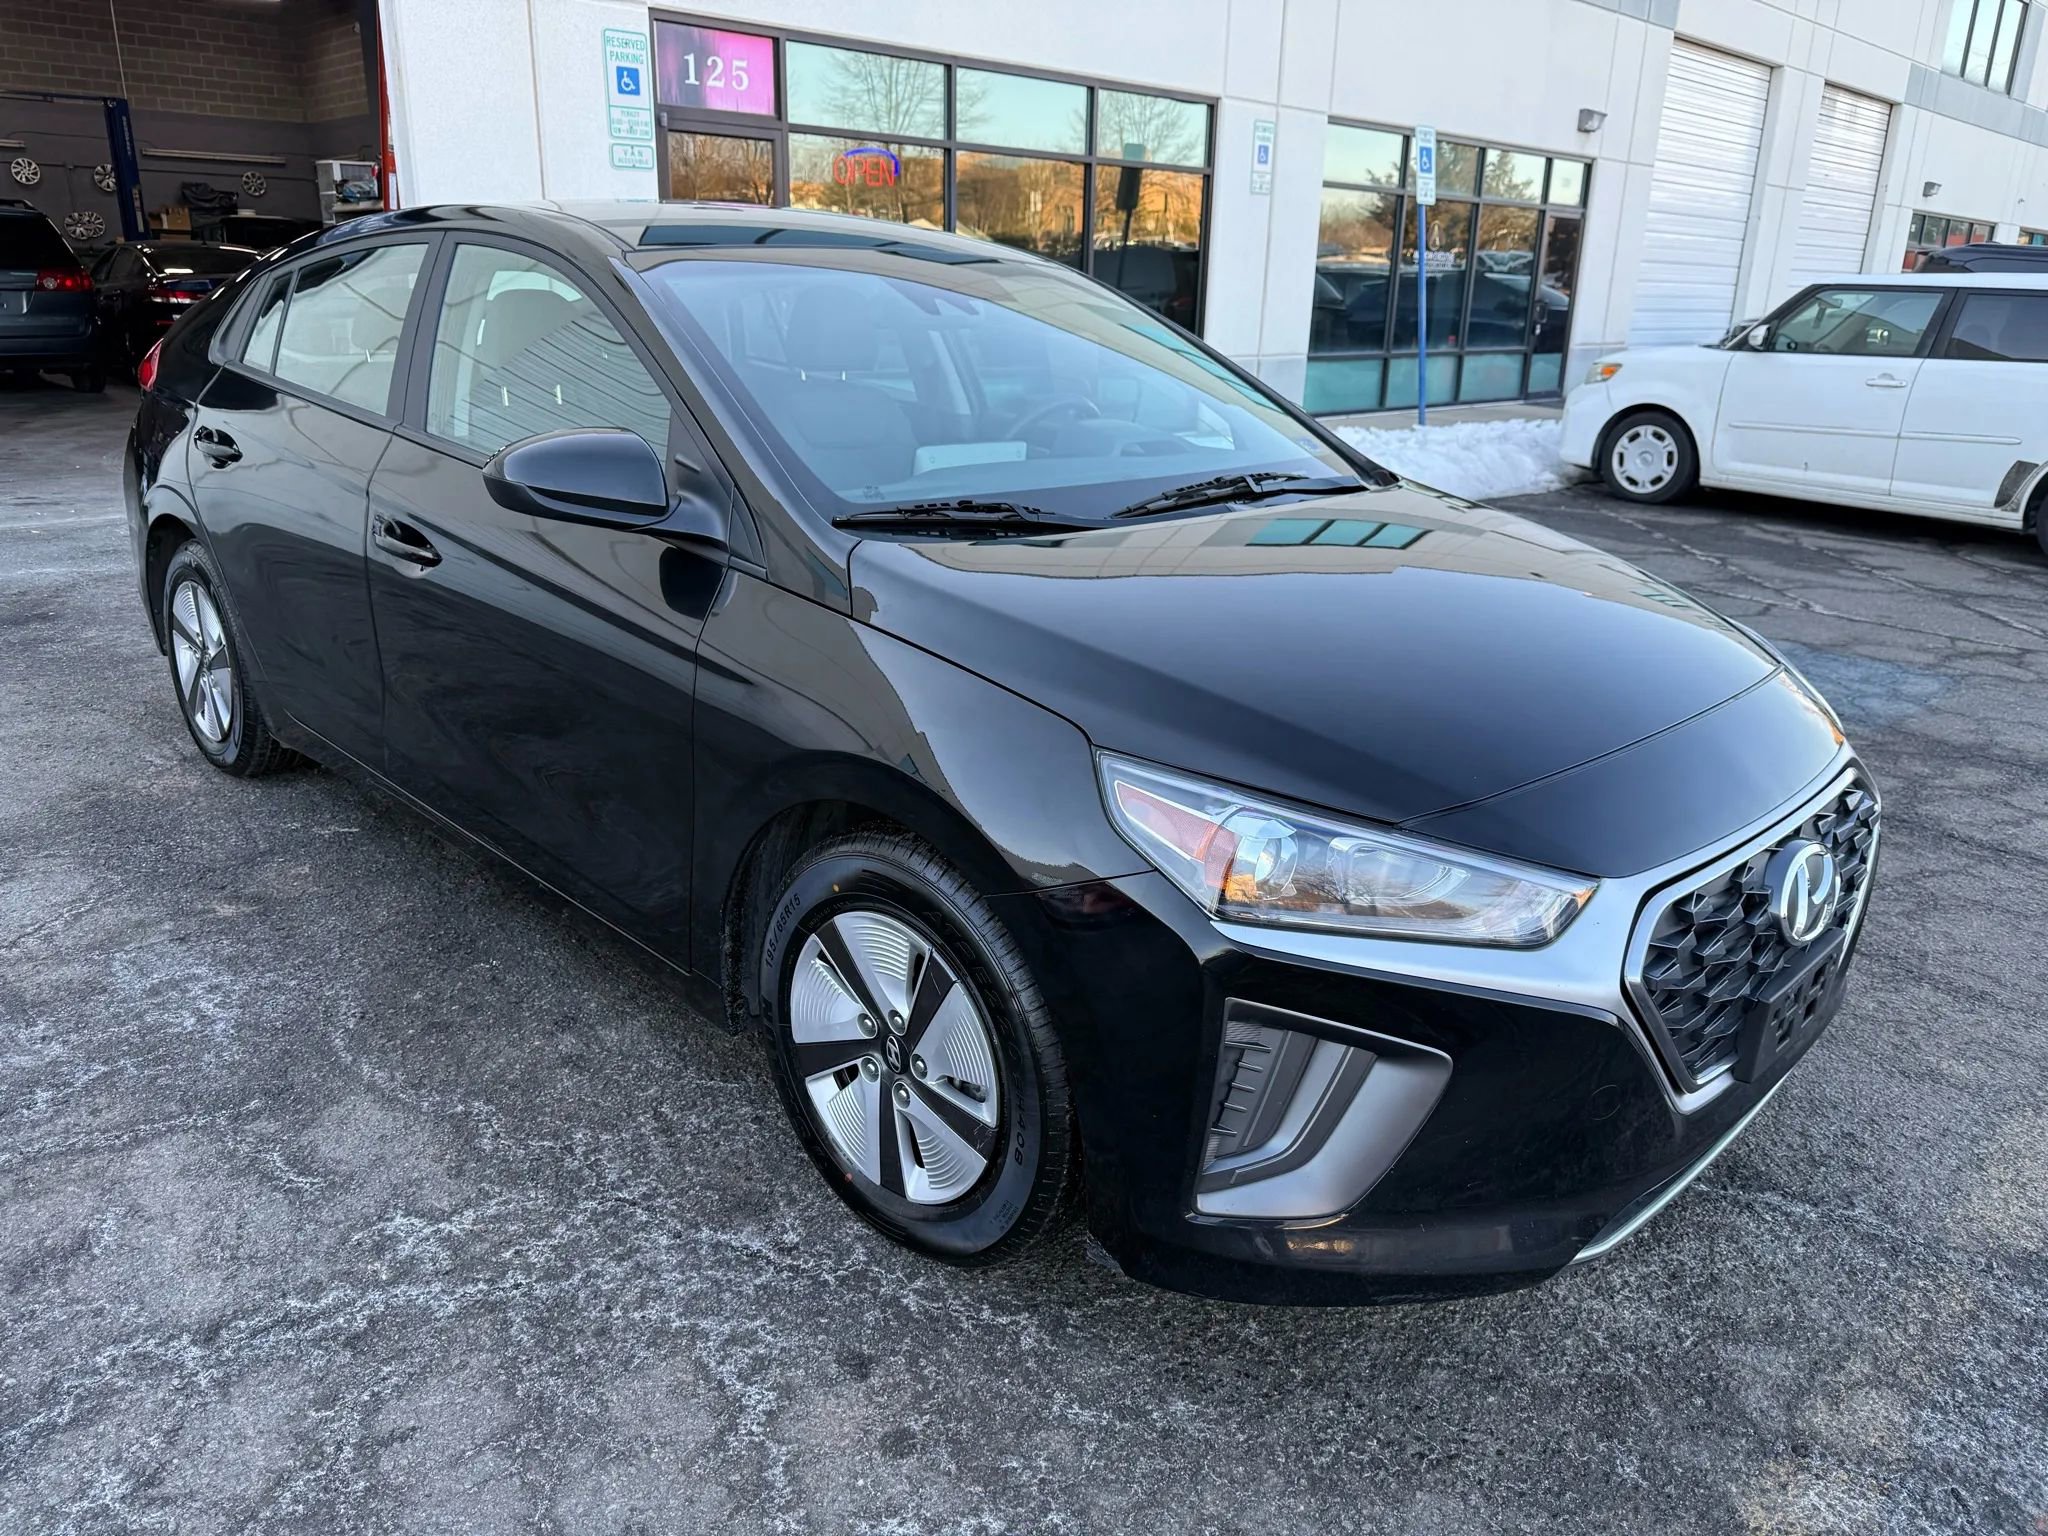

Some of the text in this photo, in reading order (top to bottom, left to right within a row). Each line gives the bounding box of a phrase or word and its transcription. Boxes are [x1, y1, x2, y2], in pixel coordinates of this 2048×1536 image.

[605, 36, 646, 51] RESERVED
[609, 50, 644, 64] PARKING
[683, 53, 749, 91] 125
[833, 155, 896, 187] OPEN
[765, 893, 801, 968] 195/65R15
